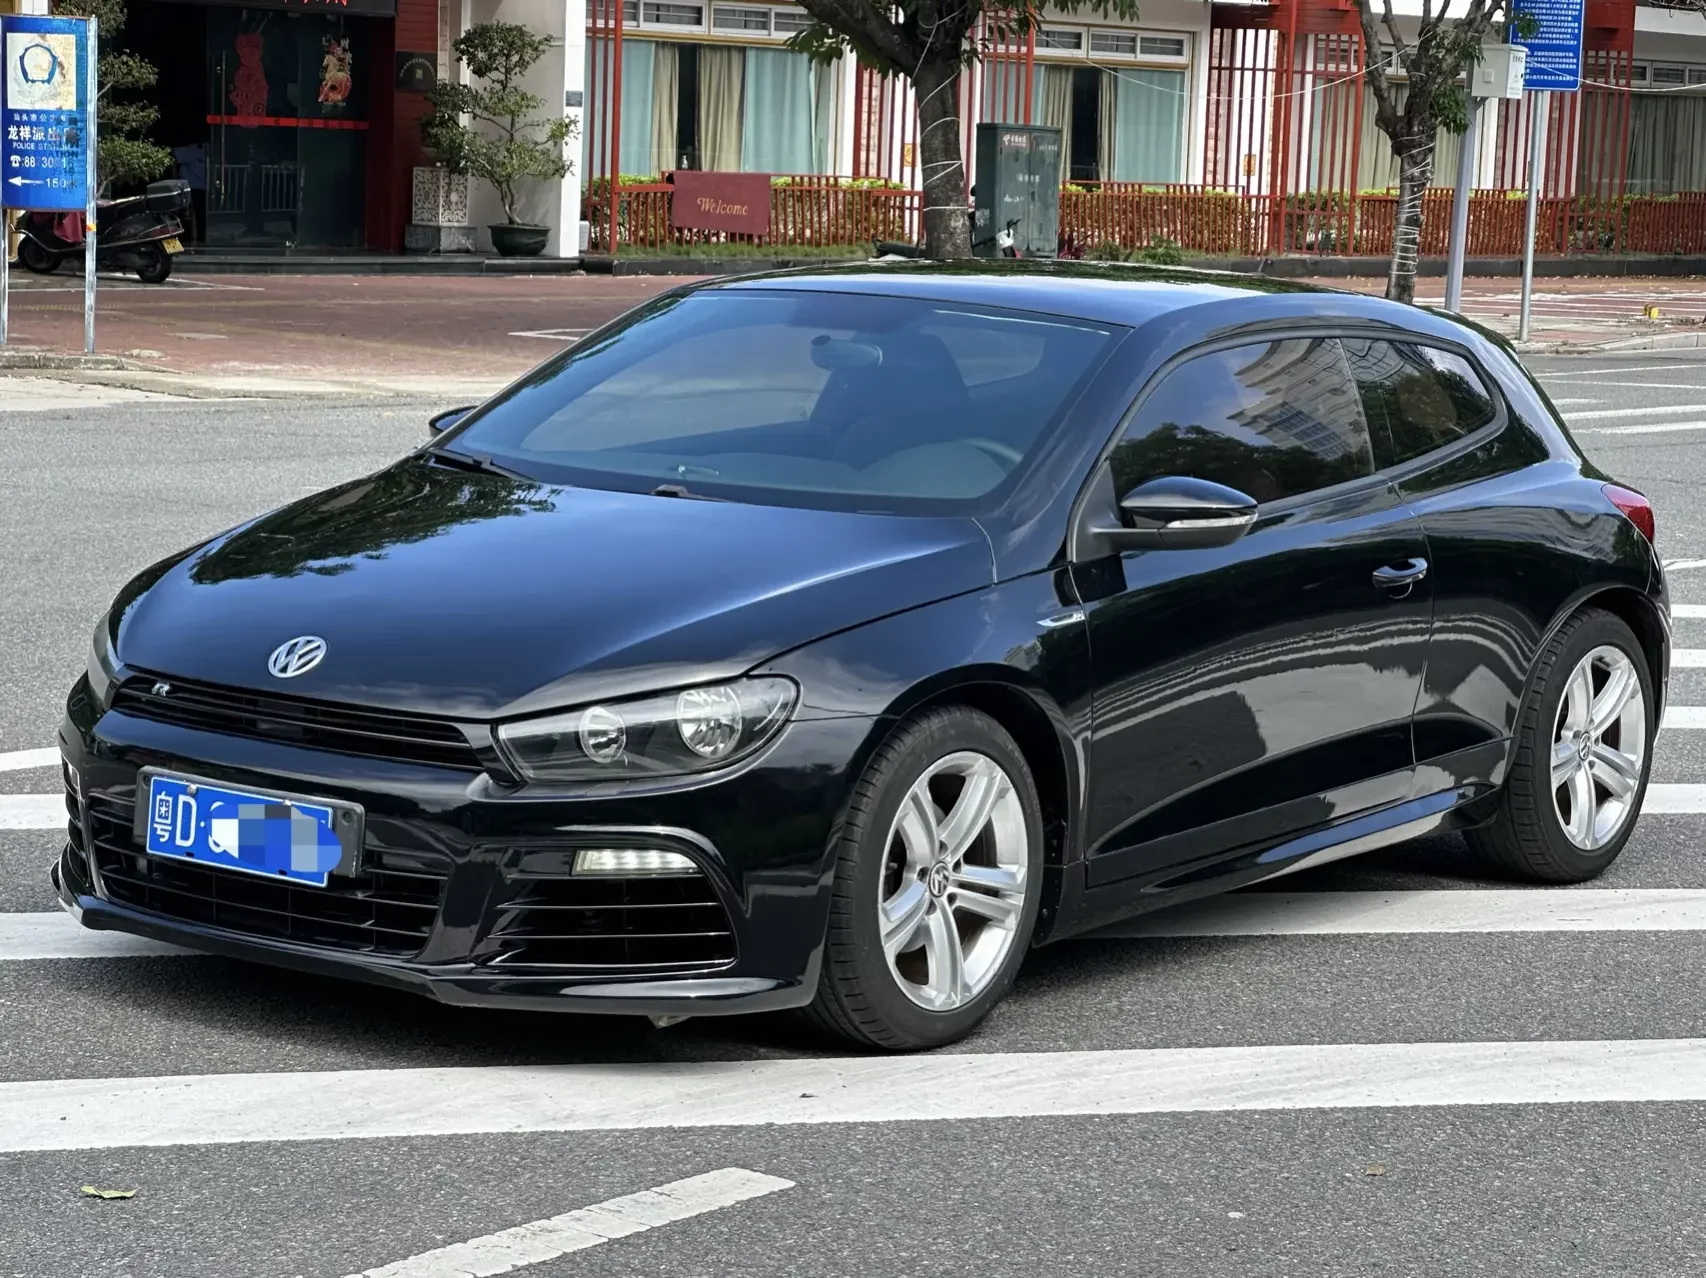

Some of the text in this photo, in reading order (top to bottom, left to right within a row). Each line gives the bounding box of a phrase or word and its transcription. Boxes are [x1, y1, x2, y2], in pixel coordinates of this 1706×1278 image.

[8, 125, 76, 141] 龙祥派出
[12, 142, 35, 150] POLICE
[697, 197, 748, 215] Welcome
[151, 682, 170, 697] R
